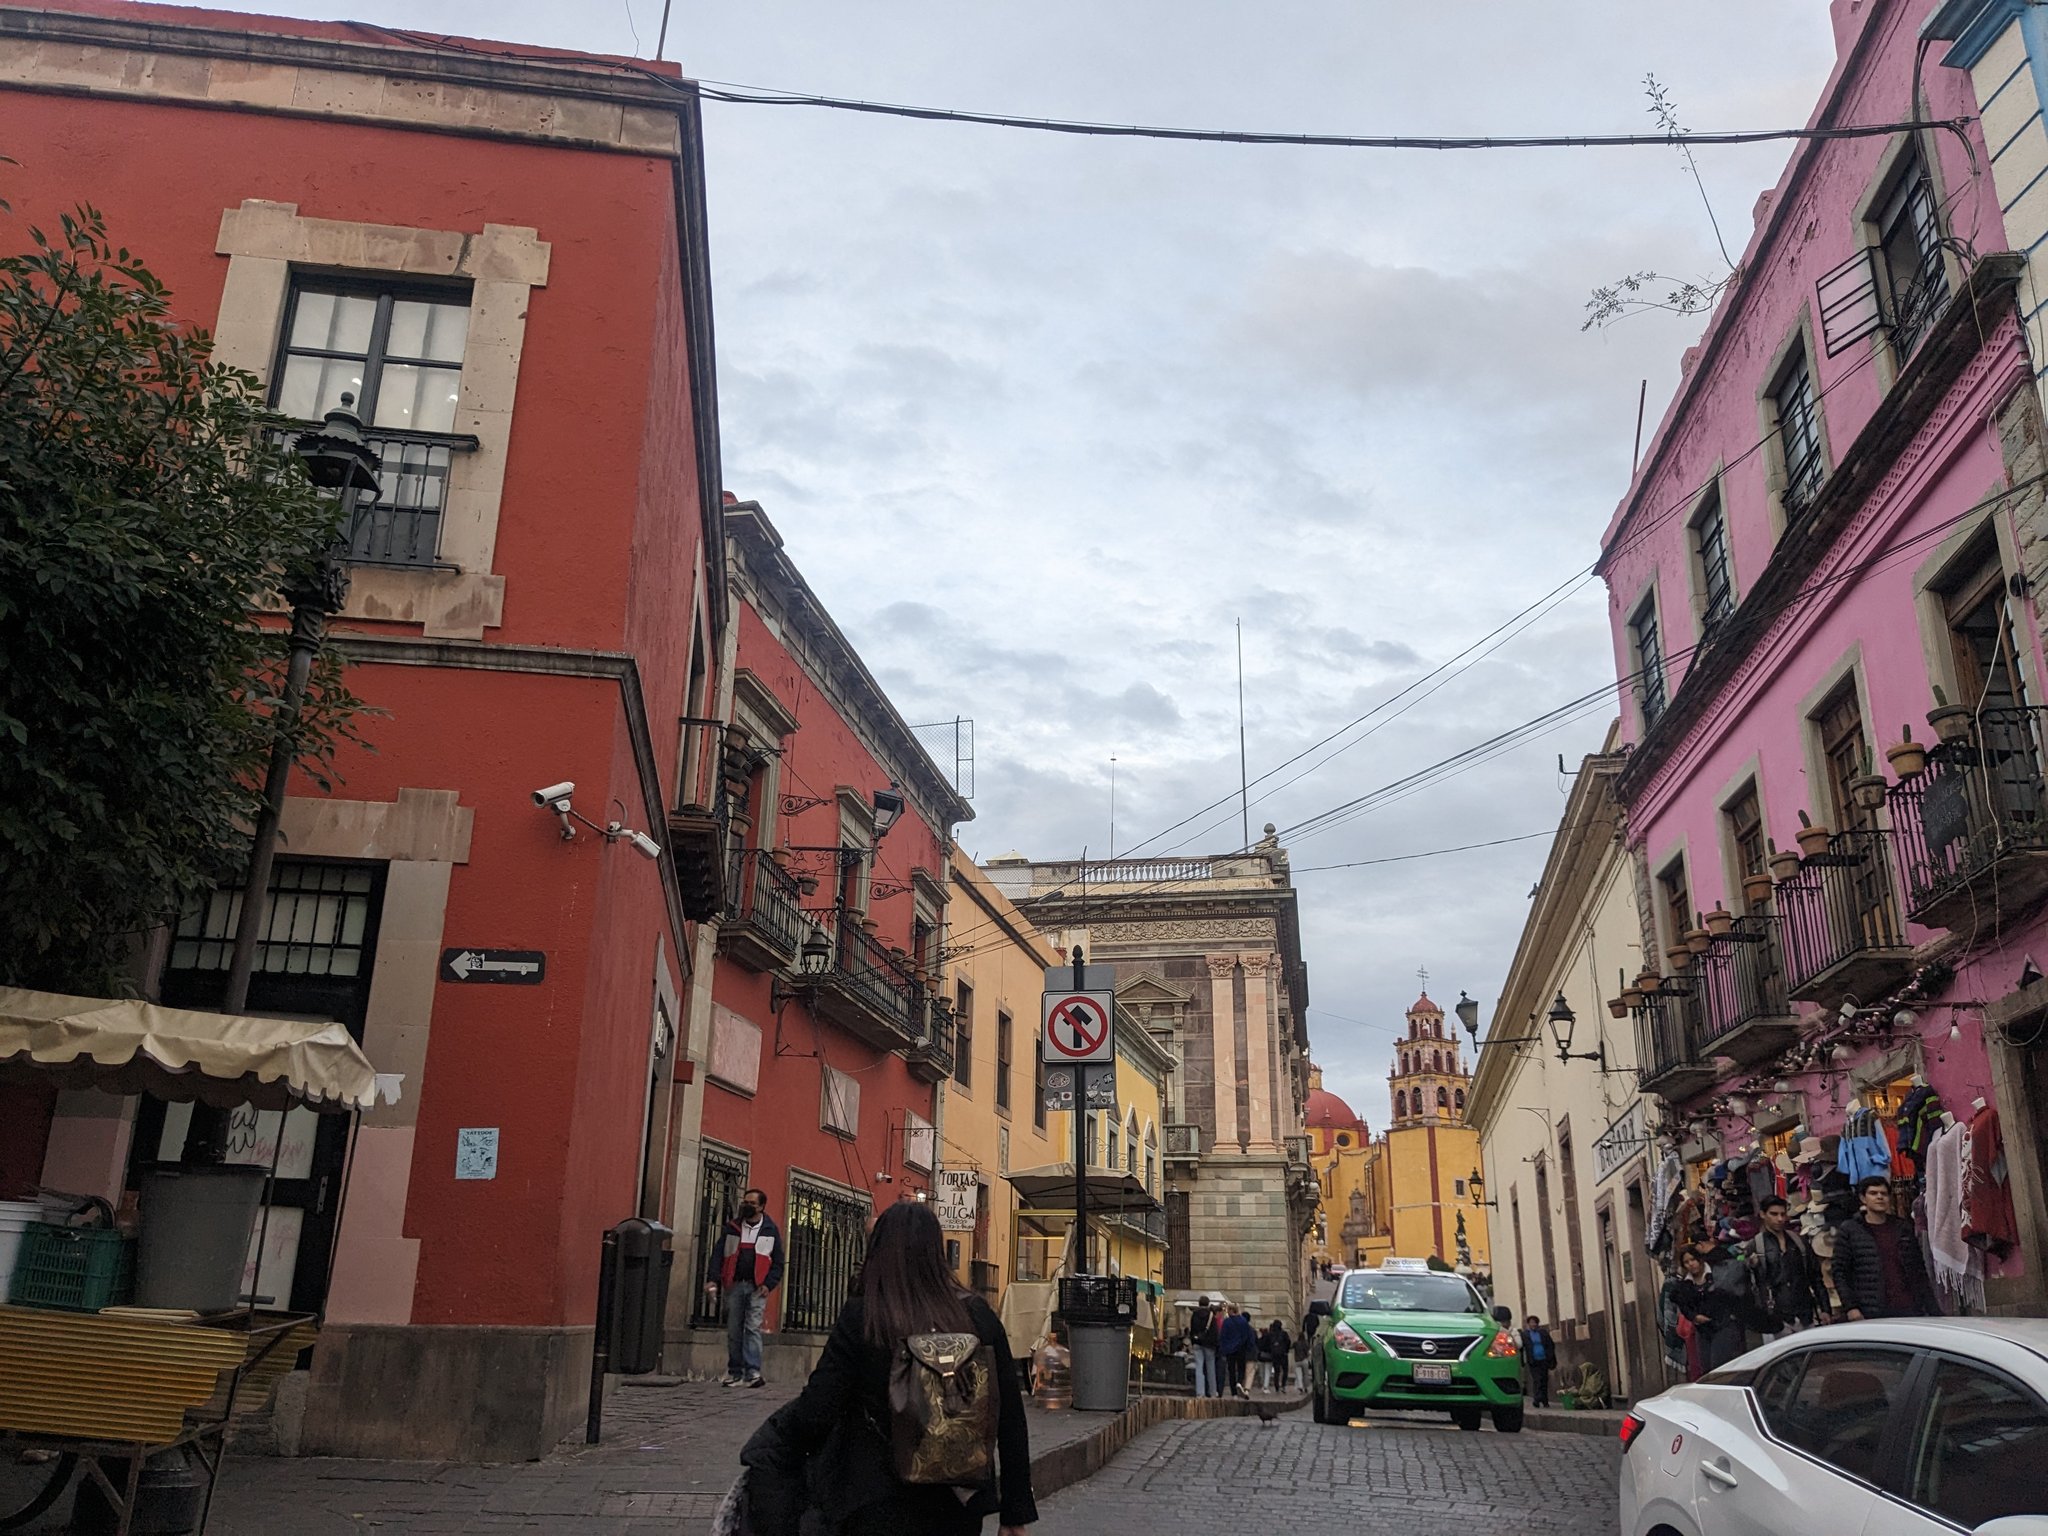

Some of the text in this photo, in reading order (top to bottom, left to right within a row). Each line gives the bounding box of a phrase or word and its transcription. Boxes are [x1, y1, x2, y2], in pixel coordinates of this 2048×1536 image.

[941, 1172, 978, 1188] TORTAS
[952, 1193, 964, 1206] LA
[938, 1206, 975, 1220] PULGA
